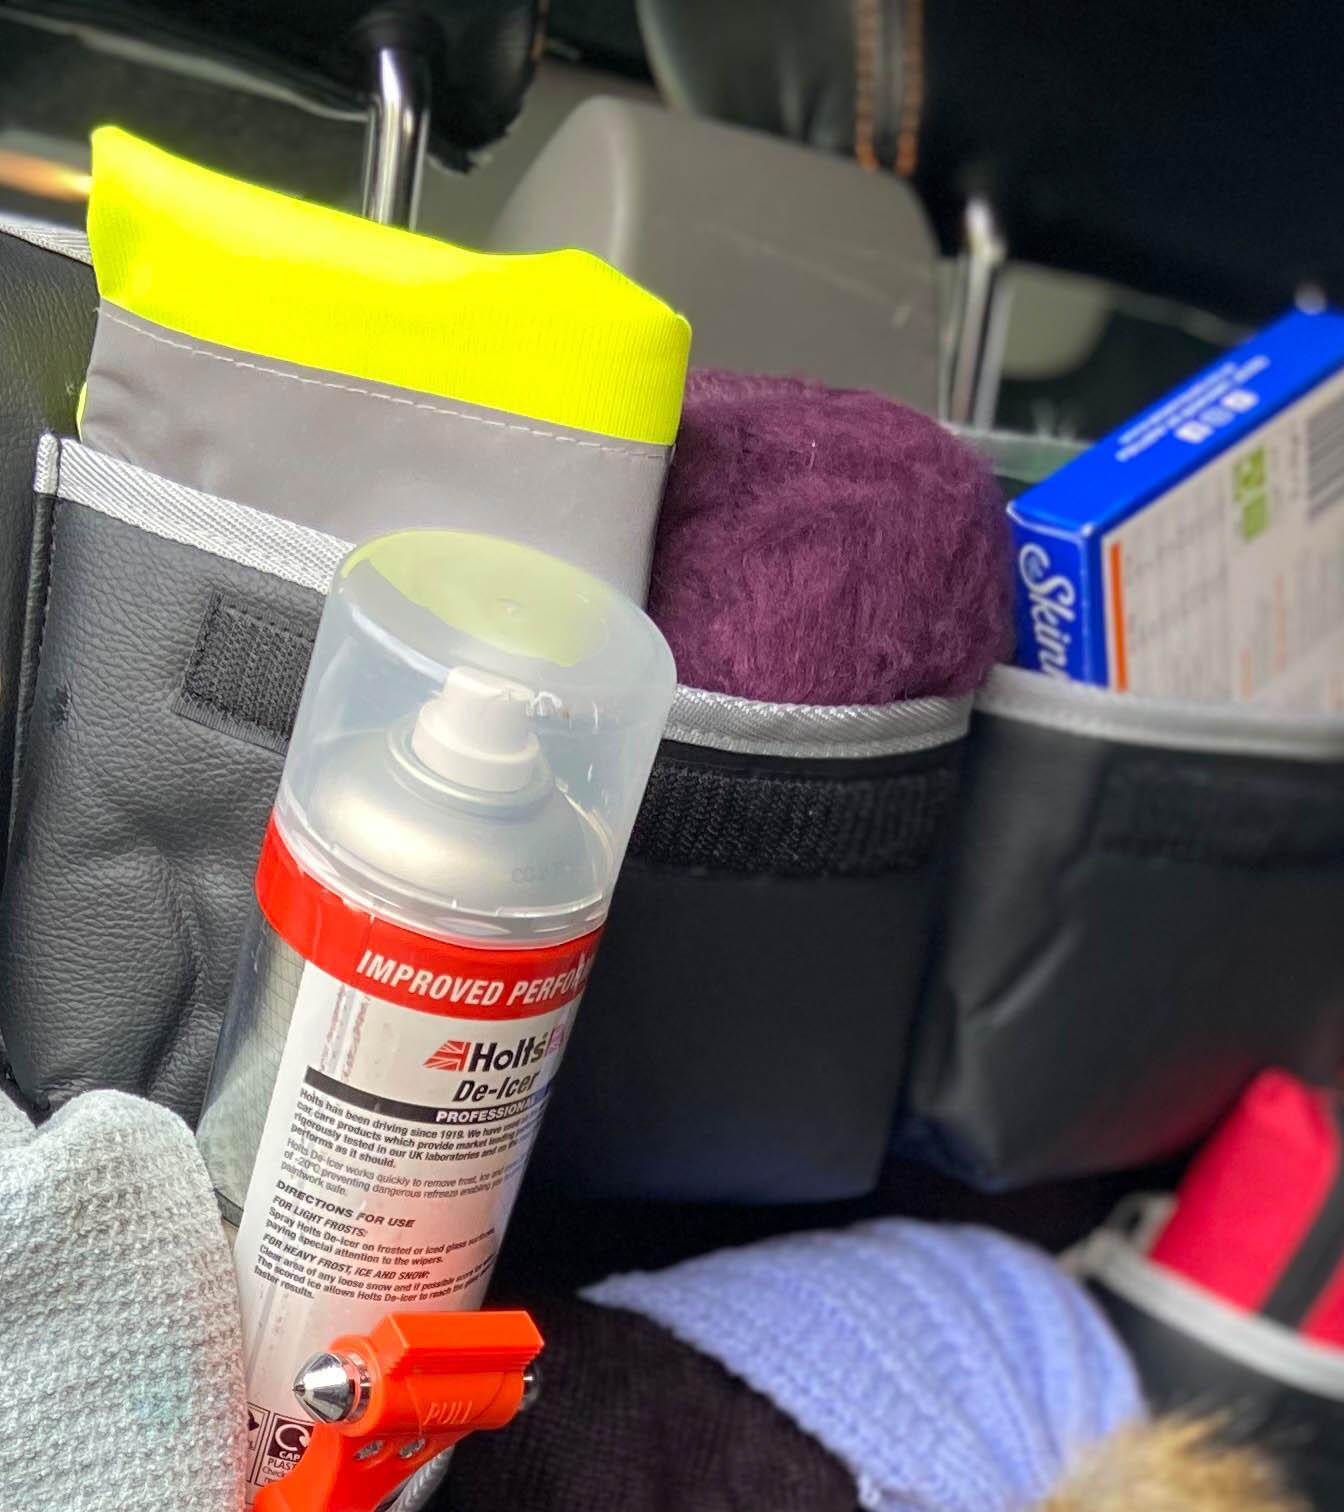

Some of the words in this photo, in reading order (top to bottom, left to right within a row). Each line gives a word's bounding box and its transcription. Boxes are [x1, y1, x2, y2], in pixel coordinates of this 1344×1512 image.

[356, 949, 504, 1006] IMPROVED
[468, 1036, 546, 1072] Holts
[452, 1071, 540, 1102] De-Icer
[294, 1111, 342, 1142] rigorously
[343, 1133, 375, 1152] tested
[376, 1142, 387, 1155] in
[388, 1147, 407, 1159] our
[408, 1149, 424, 1161] UK
[424, 1149, 480, 1162] laboratories
[300, 1088, 324, 1107] Holts
[325, 1102, 343, 1116] has
[345, 1110, 370, 1126] been
[372, 1119, 408, 1136] driving
[410, 1128, 437, 1139] since
[467, 1129, 480, 1138] We
[482, 1125, 501, 1137] have
[314, 1111, 335, 1125] care
[336, 1119, 381, 1141] products
[383, 1134, 415, 1148] which
[417, 1139, 454, 1151] provide
[456, 1137, 487, 1150] market
[286, 1138, 309, 1157] Holts
[345, 1165, 375, 1181] works
[376, 1173, 410, 1187] quickly
[412, 1178, 423, 1187] to
[423, 1178, 456, 1188] remove
[290, 1123, 334, 1150] performs
[334, 1144, 348, 1155] as
[349, 1147, 357, 1159] it
[358, 1150, 396, 1168] should.
[280, 1161, 324, 1188] paintwork
[283, 1149, 295, 1160] of
[321, 1168, 371, 1191] preventing
[372, 1183, 421, 1199] dangerous
[423, 1188, 458, 1199] refreeze
[272, 1195, 292, 1211] FOR
[293, 1205, 324, 1224] LIGHT
[323, 1218, 368, 1238] FROSTS:
[276, 1180, 354, 1218] DIRECTIONS
[355, 1212, 385, 1226] FOR
[387, 1218, 416, 1228] USE
[266, 1219, 296, 1240] paying
[298, 1232, 333, 1253] special
[334, 1246, 379, 1264] attention
[382, 1255, 391, 1265] to
[394, 1256, 409, 1266] the
[268, 1206, 296, 1228] Spray
[297, 1221, 321, 1238] Holts
[362, 1243, 375, 1252] on
[376, 1242, 412, 1255] frosted
[413, 1247, 423, 1255] or
[256, 1254, 273, 1270] The
[273, 1265, 306, 1284] scored
[307, 1278, 321, 1290] ice
[323, 1284, 355, 1298] allows
[357, 1290, 383, 1301] Holts
[419, 1291, 428, 1300] to
[259, 1244, 282, 1263] Clear
[283, 1257, 305, 1272] area
[305, 1266, 317, 1276] of
[317, 1271, 336, 1284] any
[338, 1276, 365, 1288] loose
[365, 1282, 392, 1291] snow
[394, 1283, 412, 1292] and
[263, 1233, 283, 1249] FOR
[283, 1243, 317, 1262] HEAVY
[316, 1257, 353, 1275] FROST,
[354, 1267, 372, 1277] ICE
[373, 1268, 396, 1279] AND
[254, 1265, 279, 1284] faster
[280, 1280, 315, 1299] results.
[422, 1400, 472, 1426] PULL
[268, 1458, 296, 1470] PLAST
[279, 1451, 300, 1461] CAP
